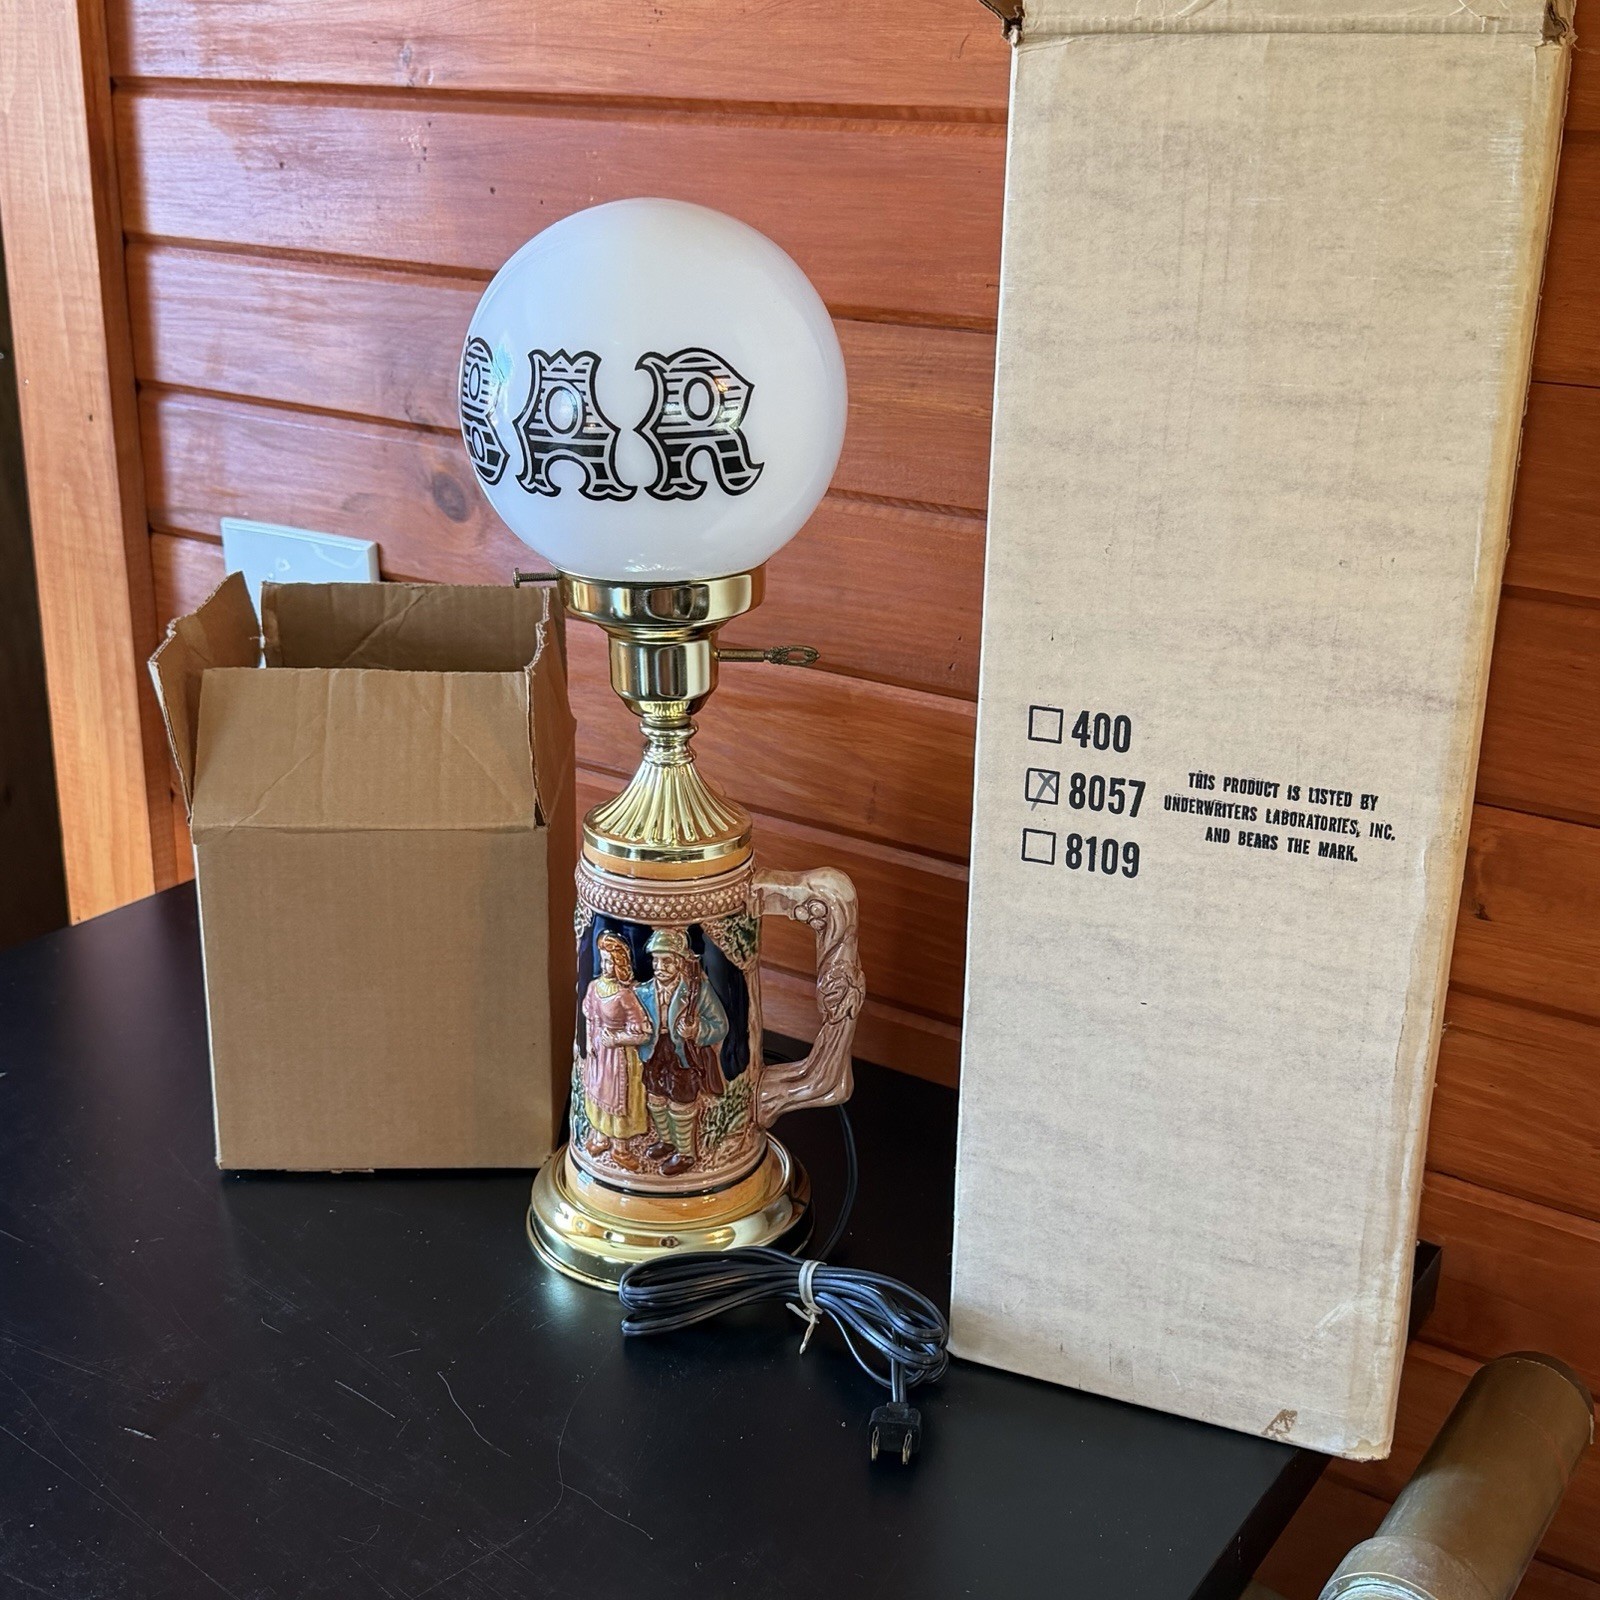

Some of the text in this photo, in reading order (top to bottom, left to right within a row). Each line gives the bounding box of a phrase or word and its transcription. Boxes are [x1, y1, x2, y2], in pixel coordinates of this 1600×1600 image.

[1071, 710, 1132, 753] 400
[1068, 772, 1147, 818] 8057
[1188, 771, 1379, 812] THIS PRODUCT IS LISTED BY
[1163, 794, 1396, 841] UNDERWRITERS LABORATORIES, INC.
[1065, 833, 1140, 879] 8109
[1205, 826, 1358, 863] AND BEARS THE MARK.
